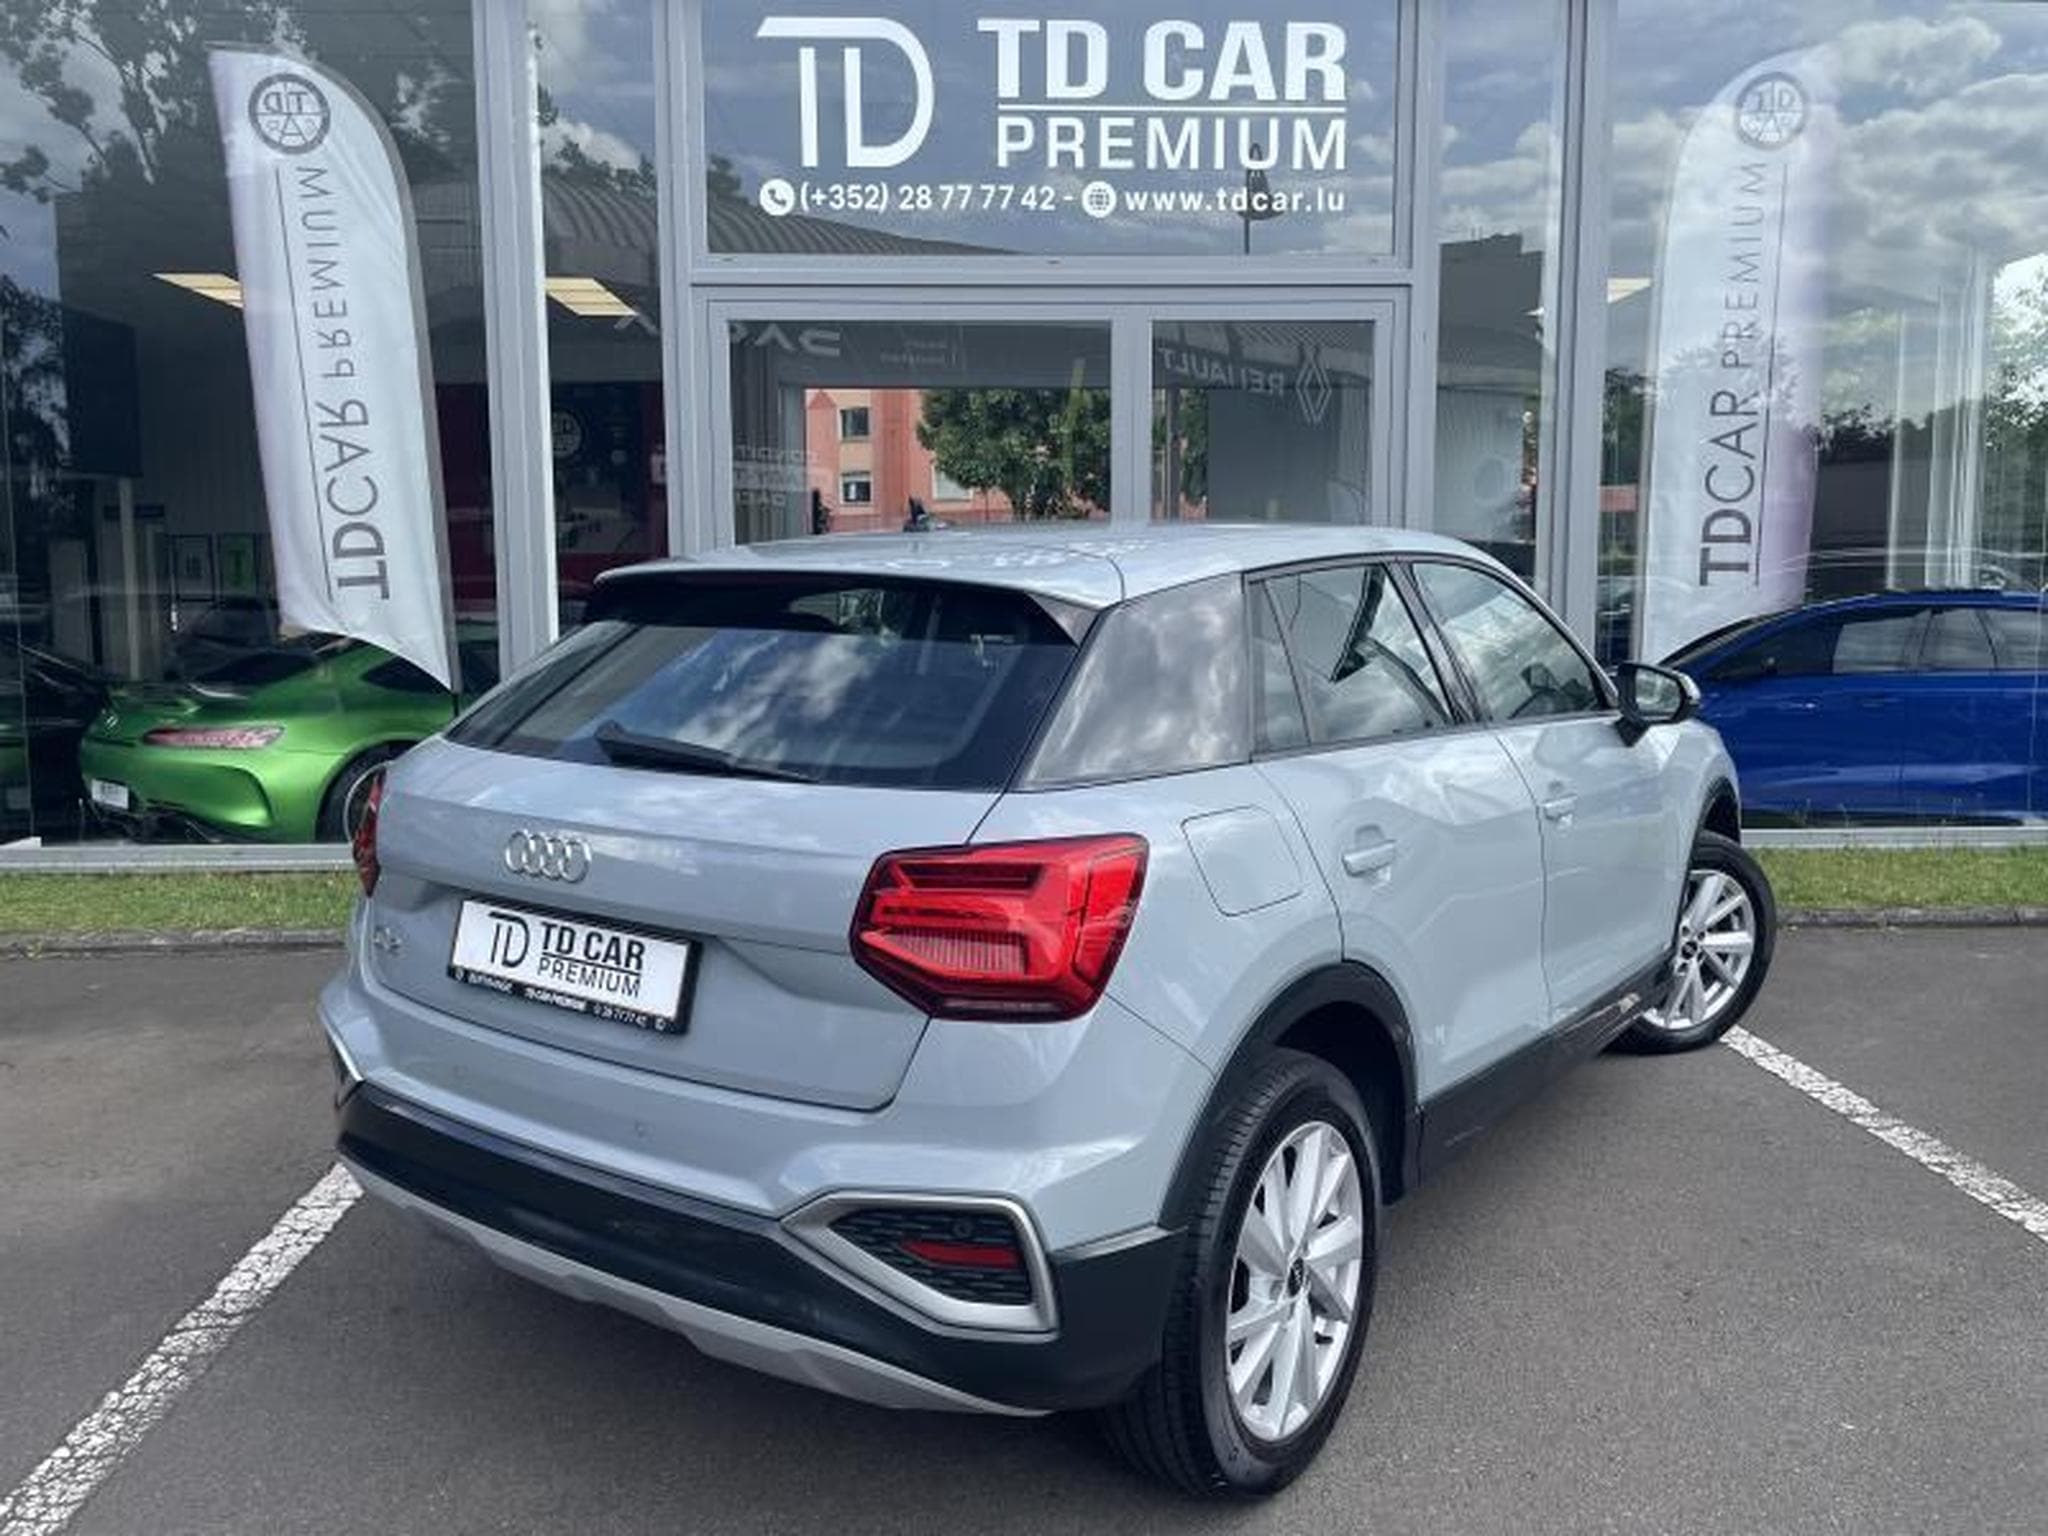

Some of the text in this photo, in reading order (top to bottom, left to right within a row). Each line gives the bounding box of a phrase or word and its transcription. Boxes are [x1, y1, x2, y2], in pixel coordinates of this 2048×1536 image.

[977, 19, 1347, 100] TD CAR
[998, 116, 1346, 169] PREMIUM
[800, 181, 888, 213] (+352)
[899, 184, 932, 210] 28
[939, 184, 972, 210] 77
[980, 184, 1014, 210] 77
[1020, 184, 1055, 210] 42
[1125, 184, 1345, 212] www.tdcar.lu
[1700, 161, 1767, 587] TDCAR PREMIUM
[541, 920, 646, 971] TD CAR
[537, 956, 641, 998] PREMIUM
